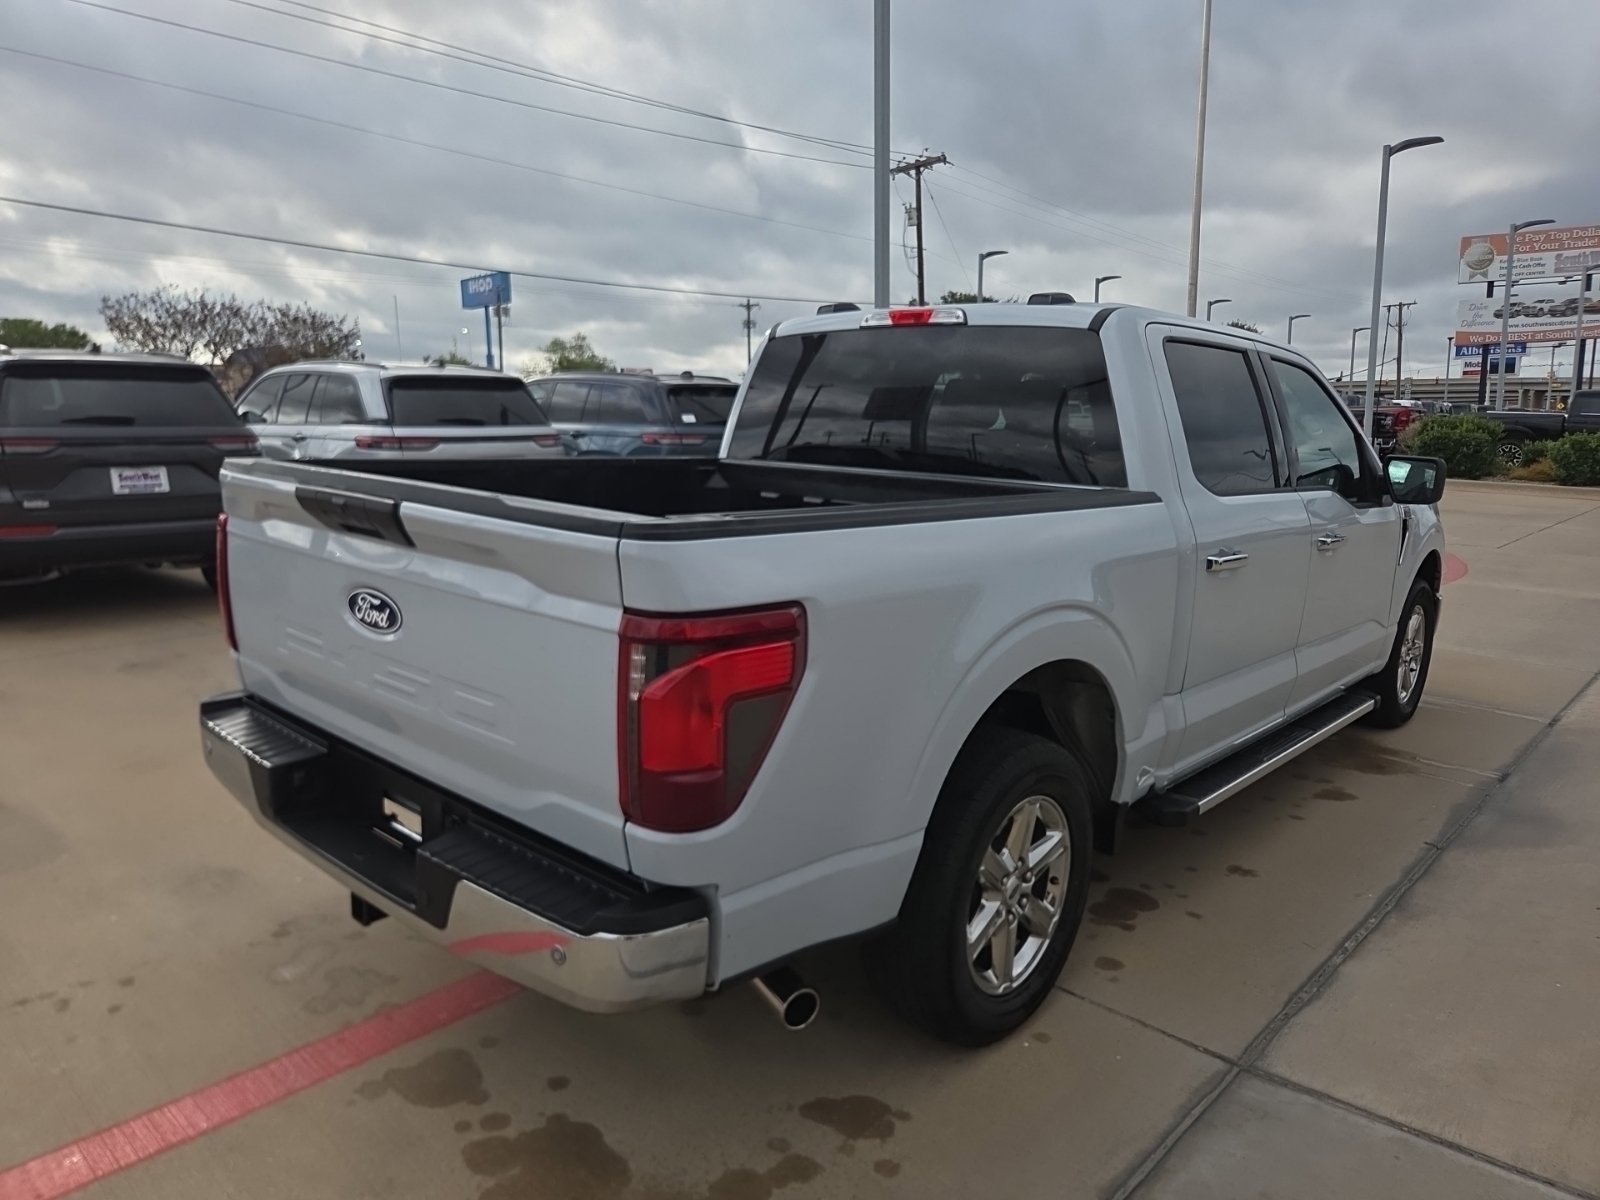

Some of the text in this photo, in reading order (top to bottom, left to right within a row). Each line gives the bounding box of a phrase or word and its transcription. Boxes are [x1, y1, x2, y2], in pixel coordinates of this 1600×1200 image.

[1525, 233, 1546, 242] Pay
[1548, 231, 1570, 240] Top
[1513, 238, 1598, 252] For Your Trade!
[1461, 320, 1496, 328] Difference
[1470, 335, 1484, 343] We
[1486, 334, 1498, 342] Do
[1508, 333, 1534, 341] BEST
[355, 592, 391, 628] Ford
